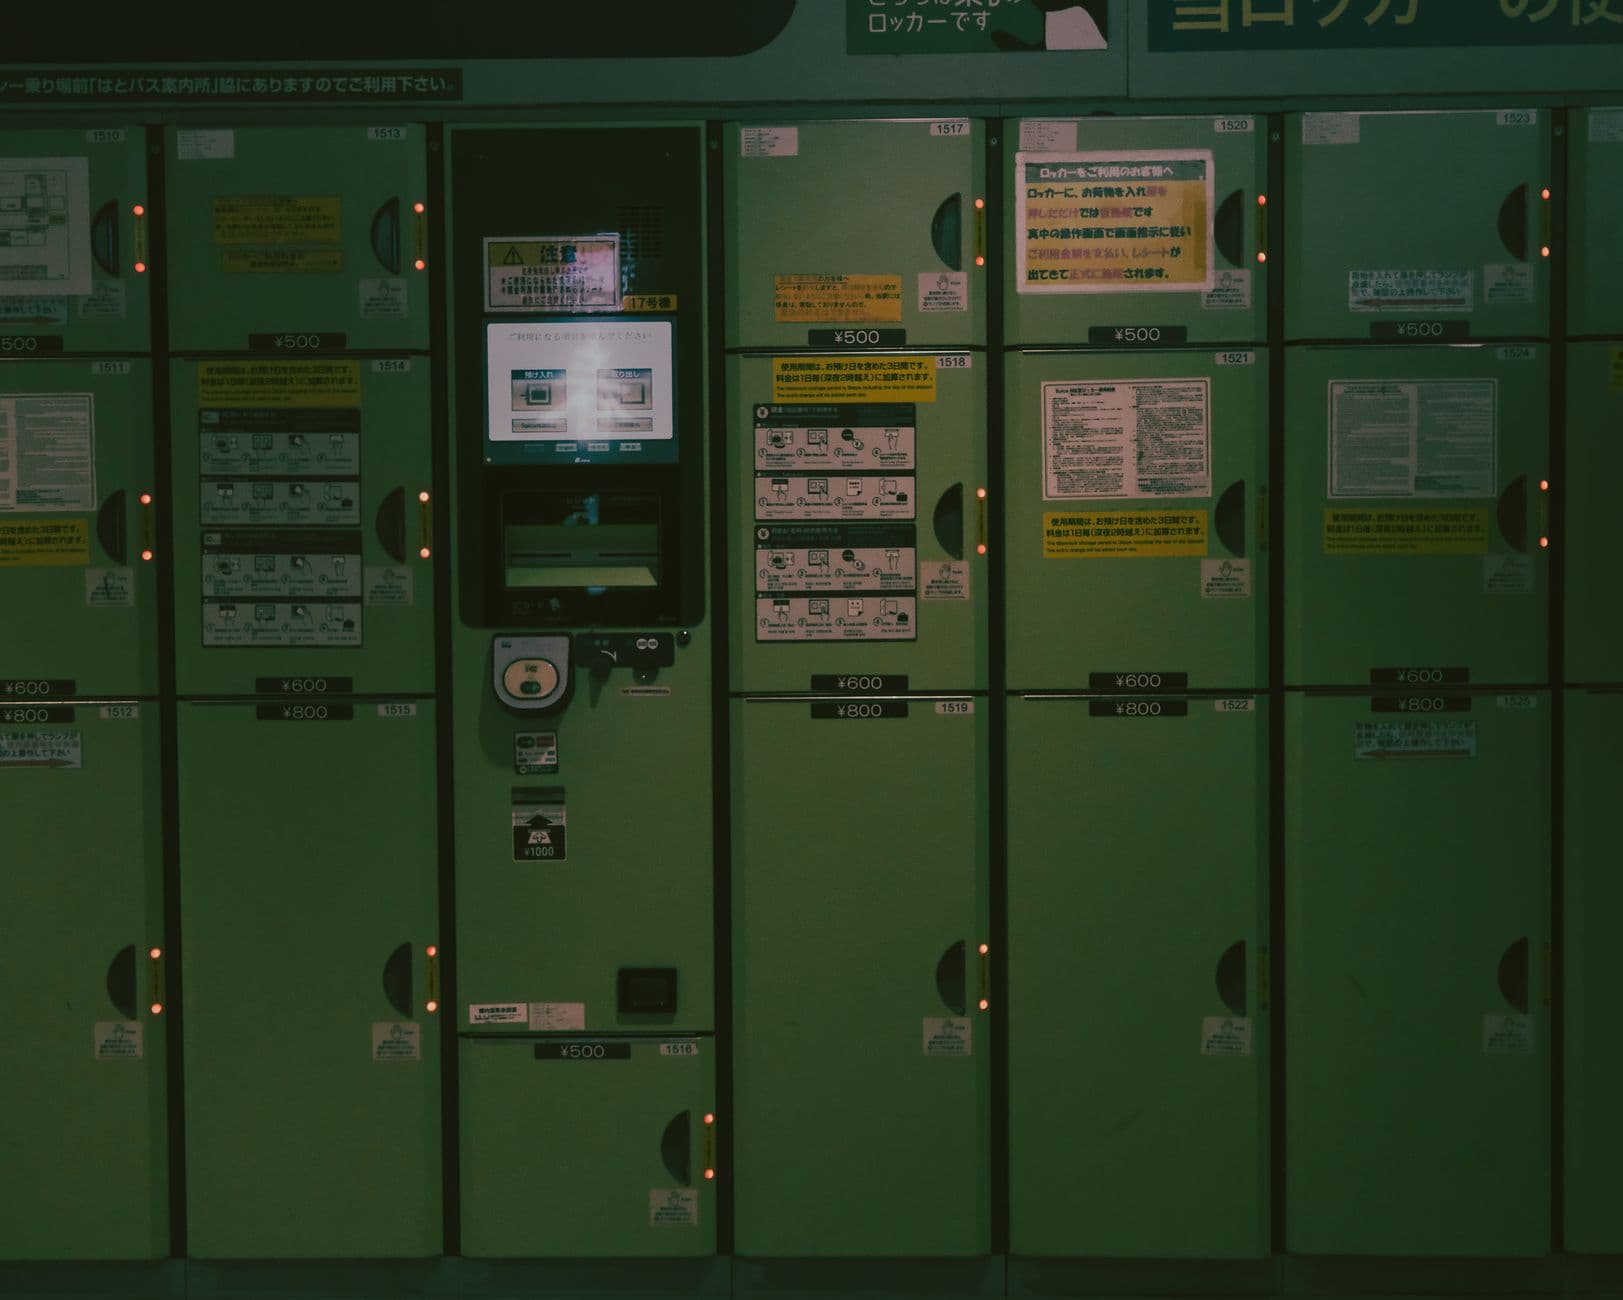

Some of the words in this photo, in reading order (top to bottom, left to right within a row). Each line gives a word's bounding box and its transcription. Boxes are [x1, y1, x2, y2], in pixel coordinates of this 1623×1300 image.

[868, 10, 991, 32] ロッカーです
[937, 124, 964, 134] 1517
[1220, 120, 1248, 130] 1520
[93, 130, 120, 141] 1510
[374, 128, 400, 138] 1513
[1040, 166, 1174, 179] ロッカーをご利用のお客様へ
[540, 245, 577, 263] 注意
[1115, 327, 1161, 342] ¥500
[1398, 322, 1444, 336] ¥500
[273, 335, 320, 348] ¥500
[834, 330, 880, 344] ¥500
[939, 358, 966, 368] 1518
[1222, 353, 1248, 364] 1521
[98, 362, 124, 372] 1511
[282, 678, 327, 692] ¥600
[838, 675, 883, 690] ¥600
[1115, 673, 1161, 688] ¥600
[5, 681, 50, 695] ¥600
[107, 706, 133, 717] 1512
[385, 705, 411, 716] 1515
[838, 703, 882, 718] ¥800
[942, 702, 968, 713] 1519
[1115, 701, 1161, 716] ¥800
[1221, 699, 1249, 710] 1522
[3, 708, 49, 723] ¥800
[282, 705, 328, 720] ¥800
[560, 1044, 605, 1059] ¥500
